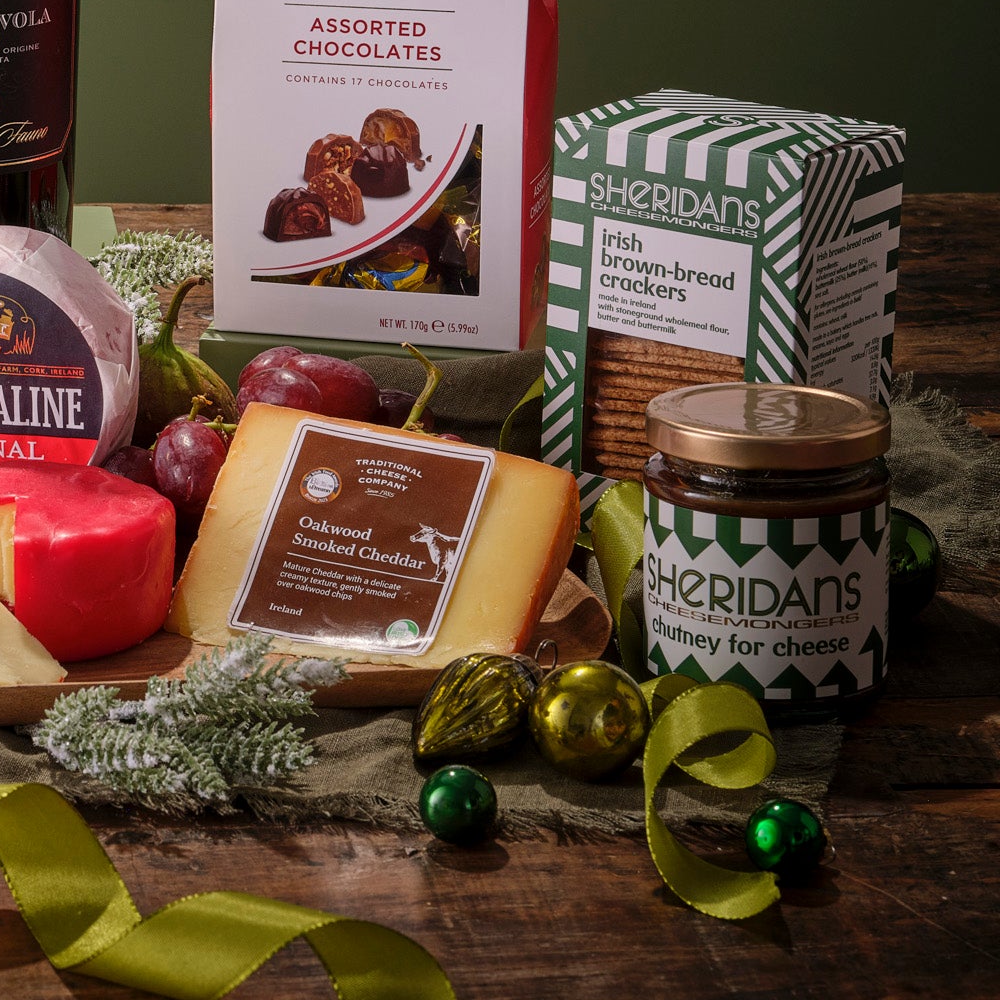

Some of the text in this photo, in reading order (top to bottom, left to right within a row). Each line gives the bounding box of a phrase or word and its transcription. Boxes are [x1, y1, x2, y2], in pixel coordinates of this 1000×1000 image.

[310, 17, 427, 37] ASSORTED
[2, 43, 40, 55] ORIGINE
[293, 40, 442, 61] CHOCOLATES
[285, 74, 448, 91] CONTAINS 17 CHOCOLATES
[590, 201, 758, 239] CHEESEMONGERS
[602, 228, 643, 253] irish
[601, 247, 735, 291] brown-bread
[600, 273, 687, 302] crackers
[598, 293, 657, 311] made in ireland
[380, 318, 393, 328] NET
[395, 319, 407, 329] WT.
[410, 320, 428, 332] 170g
[447, 323, 479, 335] (5.99oz)
[597, 312, 677, 335] butter and buttermilk
[598, 303, 730, 335] with stoneground wholemeal flour,
[50, 368, 85, 377] IRELAND
[356, 459, 423, 478] TRADITIONAL
[366, 468, 407, 482] CHEESE
[358, 477, 408, 492] COMPANY
[298, 515, 372, 542] Oakwood
[292, 532, 426, 570] Smoked Cheddar
[279, 570, 397, 599] creamy texture, gently smoked
[282, 560, 402, 591] Mature Cheddar with a delicate
[276, 580, 353, 601] over oakwood chips
[269, 602, 303, 616] Ireland
[647, 592, 859, 630] CHEESEMONGERS
[652, 614, 850, 657] chutney for cheese
